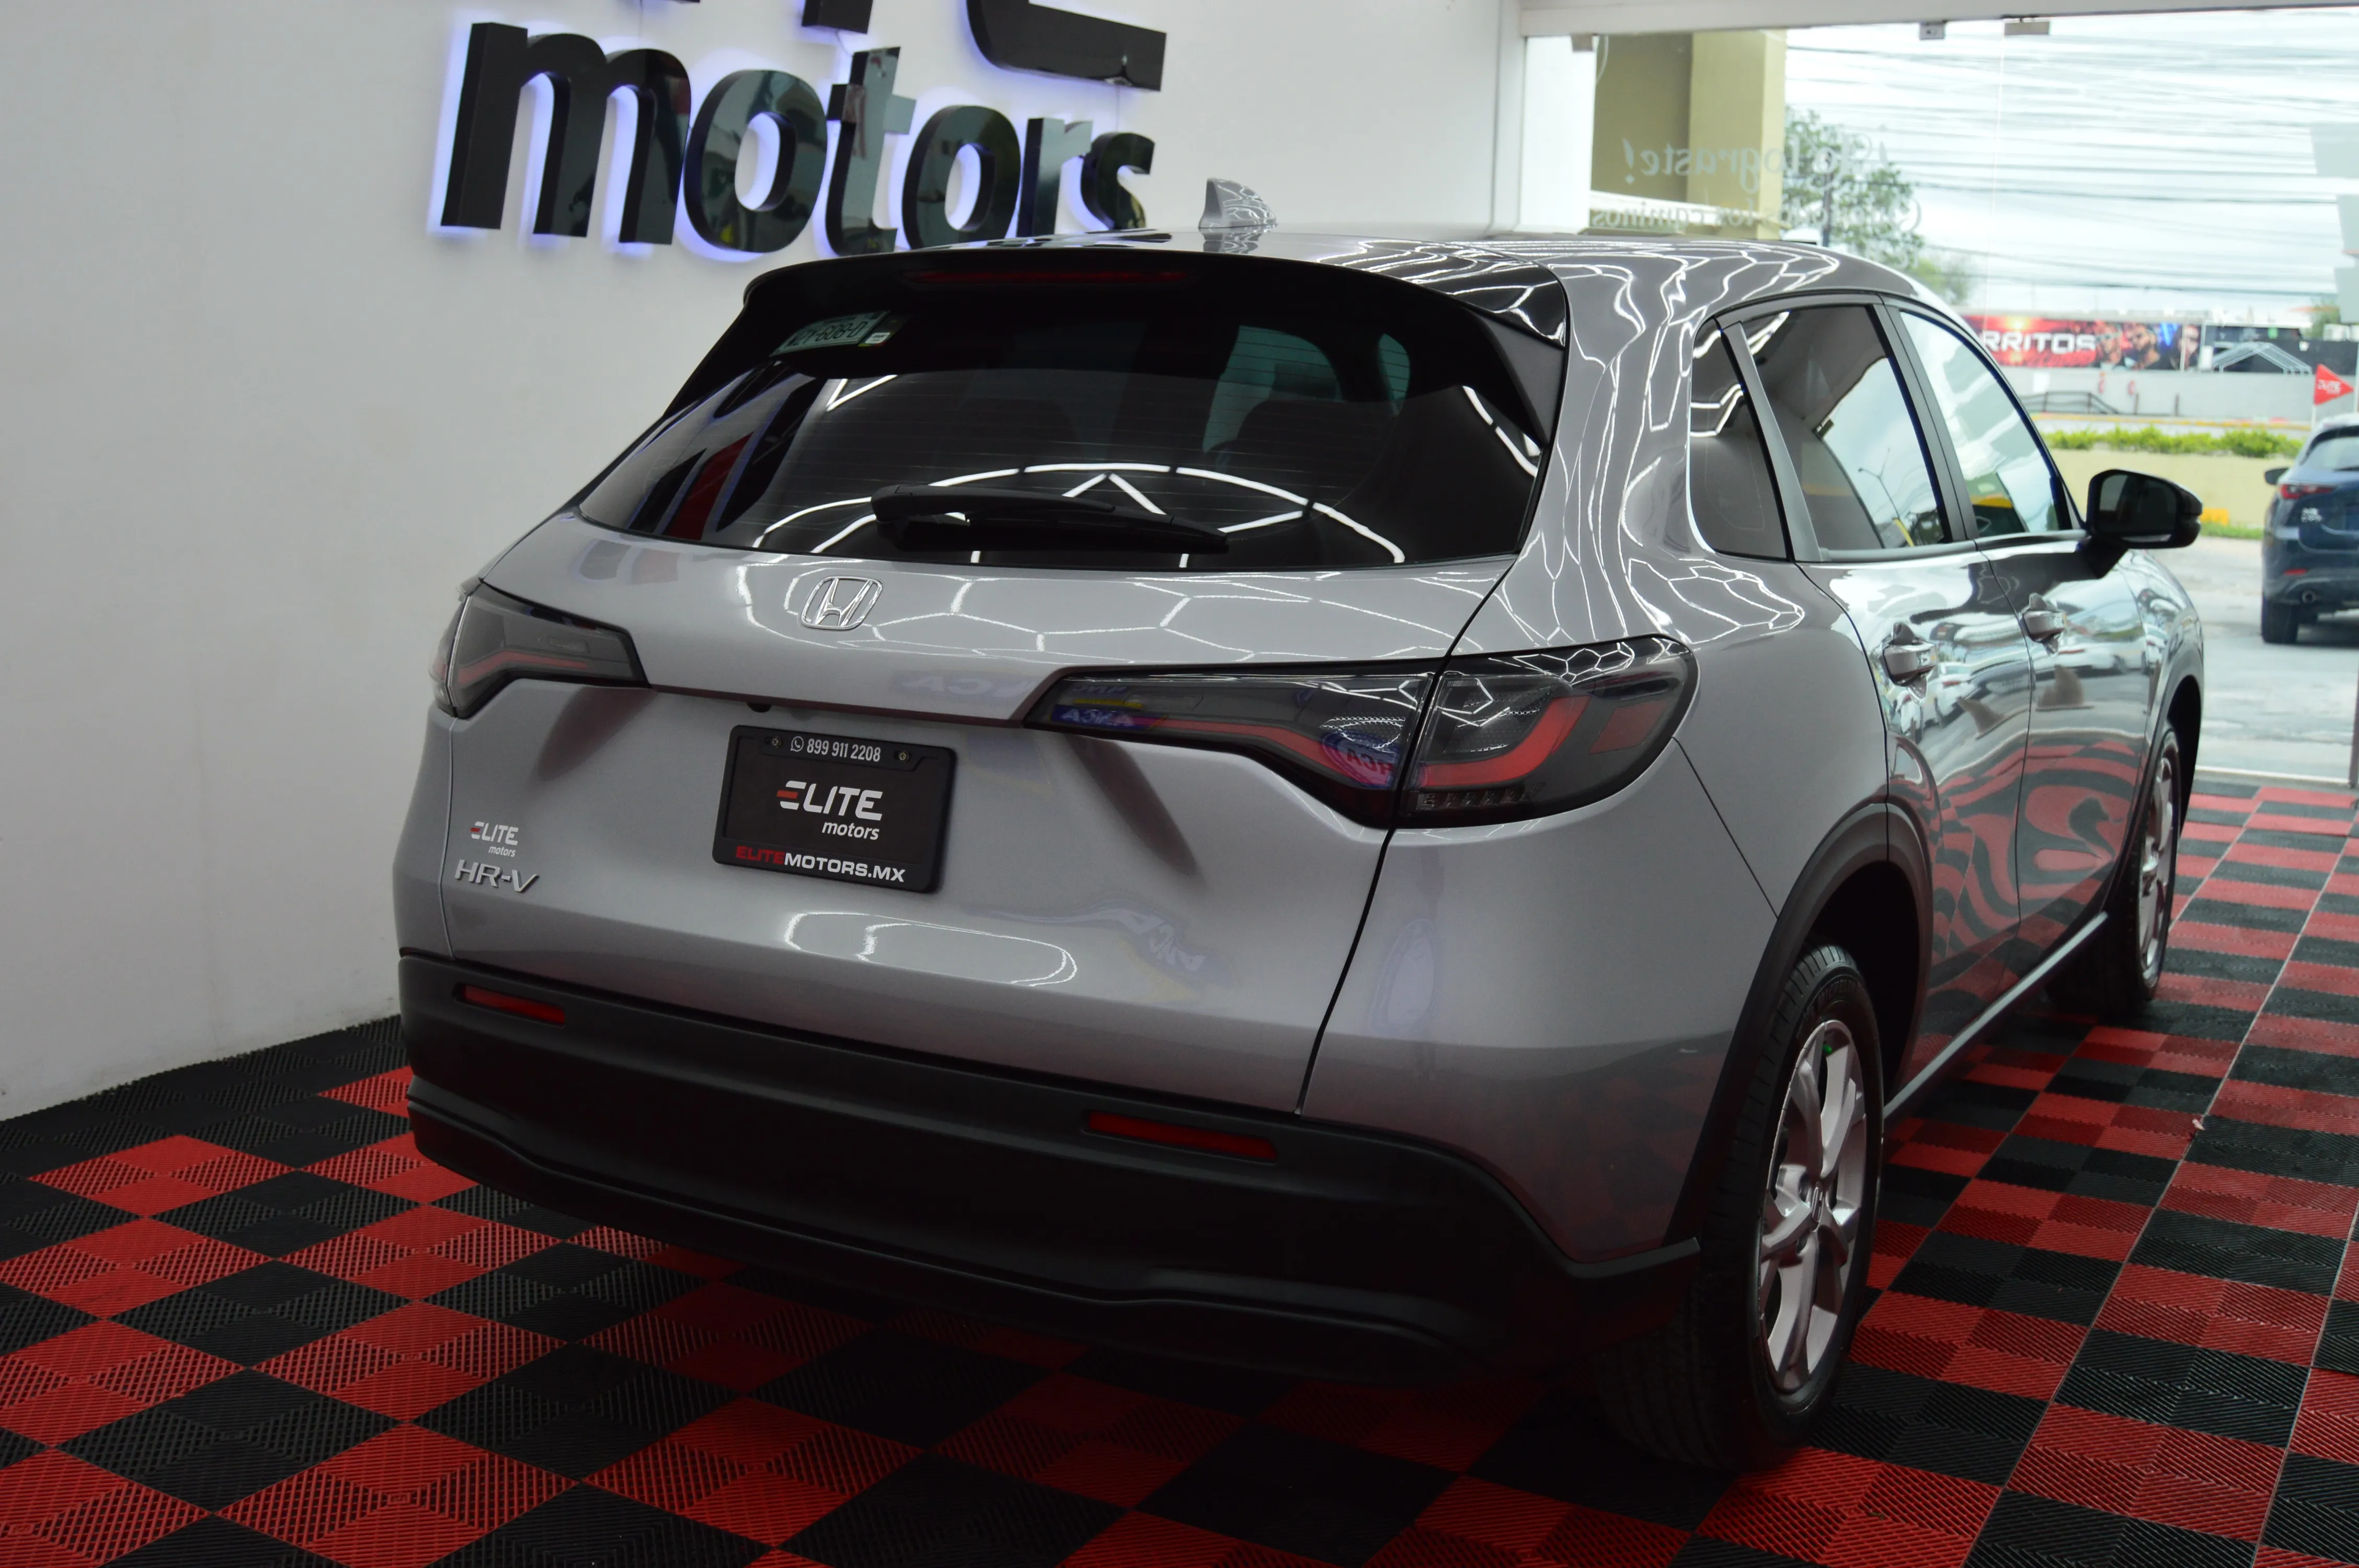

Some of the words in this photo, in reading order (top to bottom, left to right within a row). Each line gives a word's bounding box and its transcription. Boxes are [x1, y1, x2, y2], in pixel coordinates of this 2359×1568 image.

[441, 22, 1156, 256] motors
[1980, 329, 2097, 355] RRITOS
[807, 738, 829, 756] 899
[831, 741, 848, 758] 911
[850, 744, 881, 763] 2208
[776, 780, 884, 821] ELITE
[471, 821, 519, 846] ELITE
[821, 821, 880, 840] motors
[488, 845, 516, 857] motors
[735, 845, 906, 883] ELITEMOTORS.MX
[454, 859, 540, 893] HR-V
